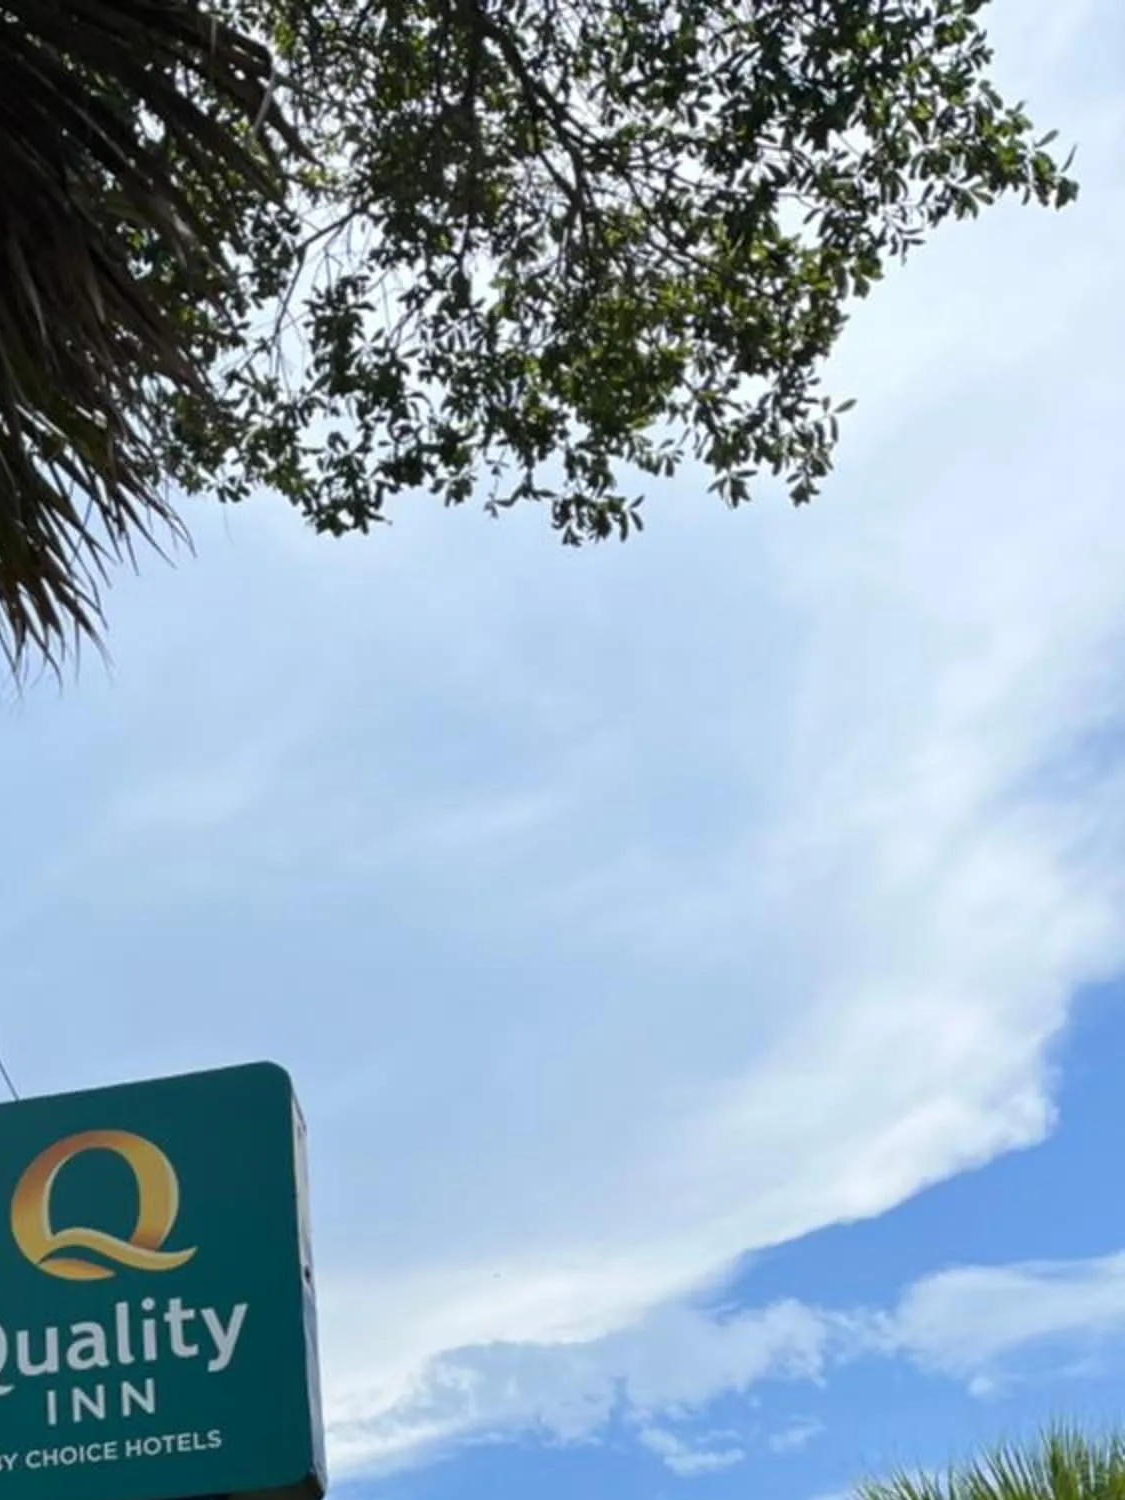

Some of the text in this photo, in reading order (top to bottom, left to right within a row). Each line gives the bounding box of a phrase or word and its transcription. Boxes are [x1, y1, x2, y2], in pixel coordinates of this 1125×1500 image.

[10, 1129, 198, 1281] Q
[46, 1378, 156, 1425] INN
[25, 1442, 119, 1470] CHOICE
[125, 1429, 222, 1457] HOTELS
